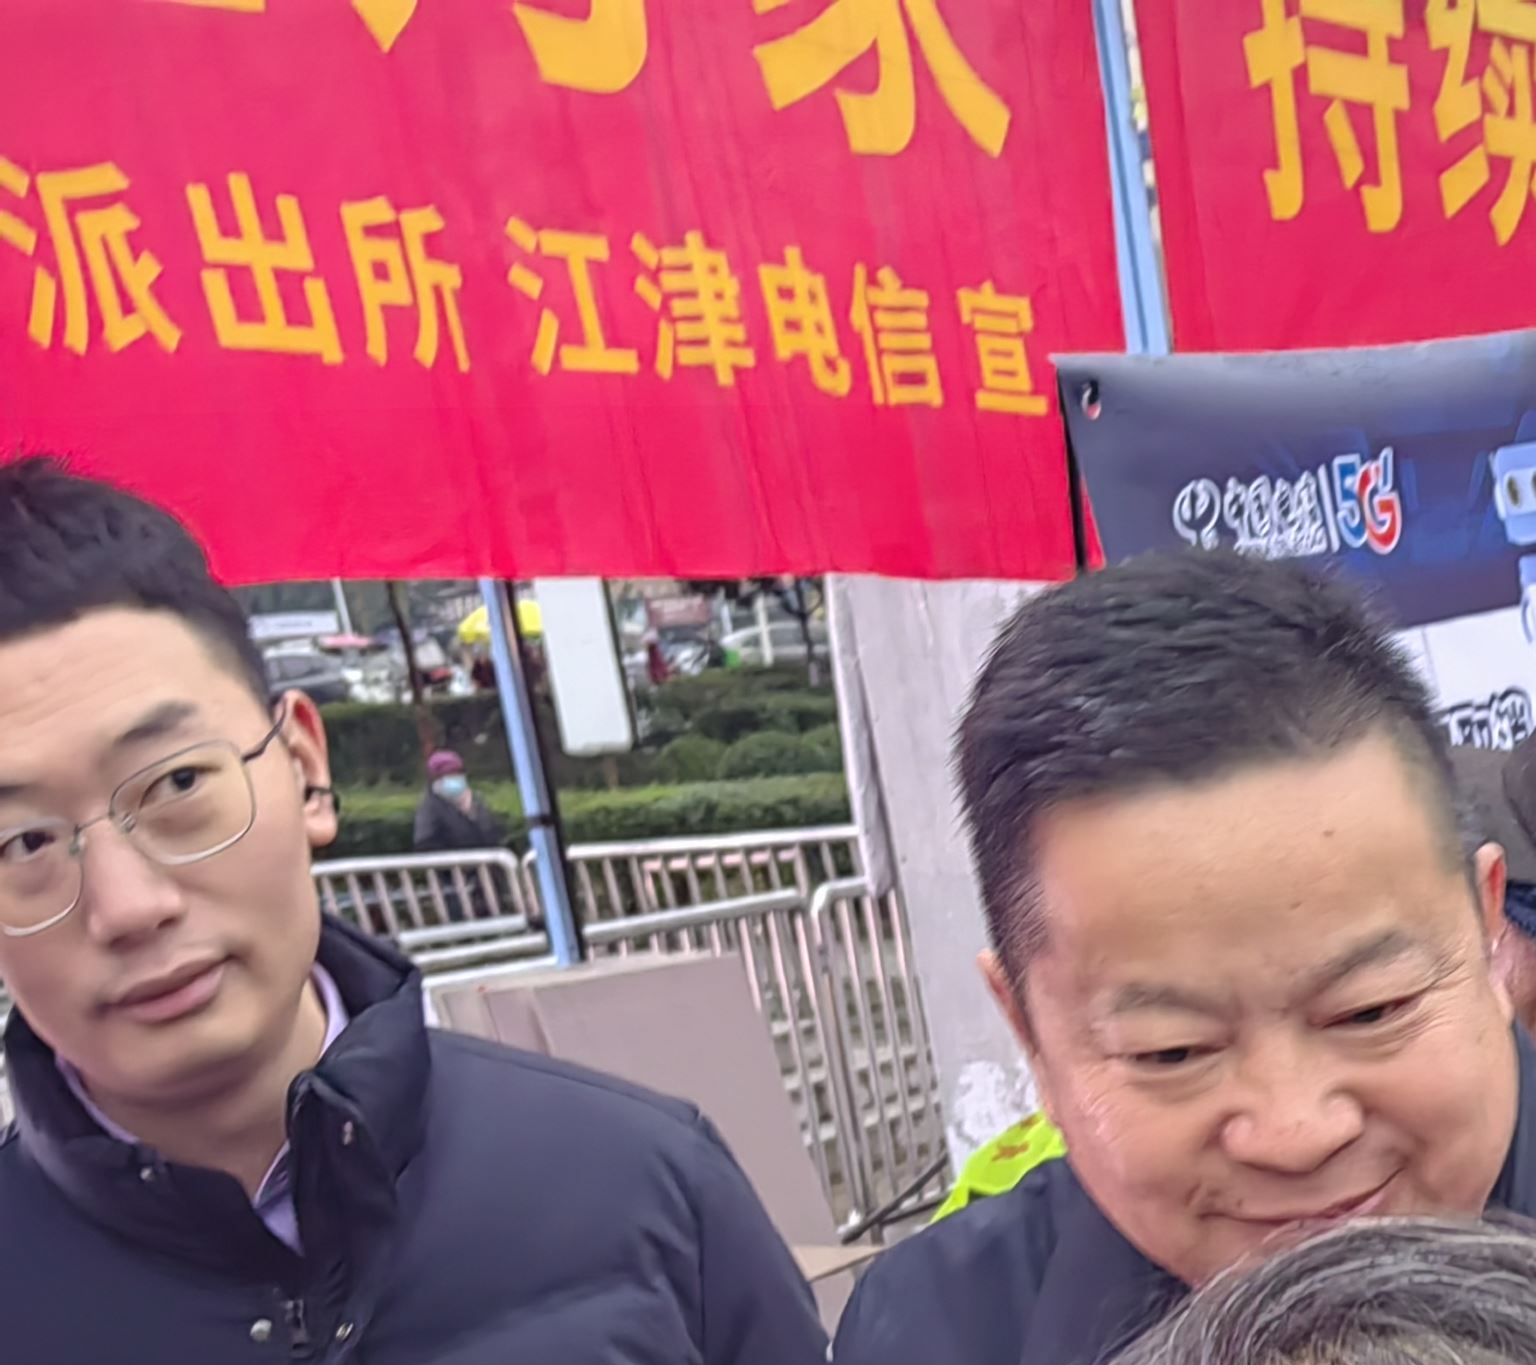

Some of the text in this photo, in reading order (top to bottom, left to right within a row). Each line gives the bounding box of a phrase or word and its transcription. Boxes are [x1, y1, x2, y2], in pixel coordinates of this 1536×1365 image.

[0, 155, 471, 373] 派出所
[1332, 446, 1402, 555] 5G
